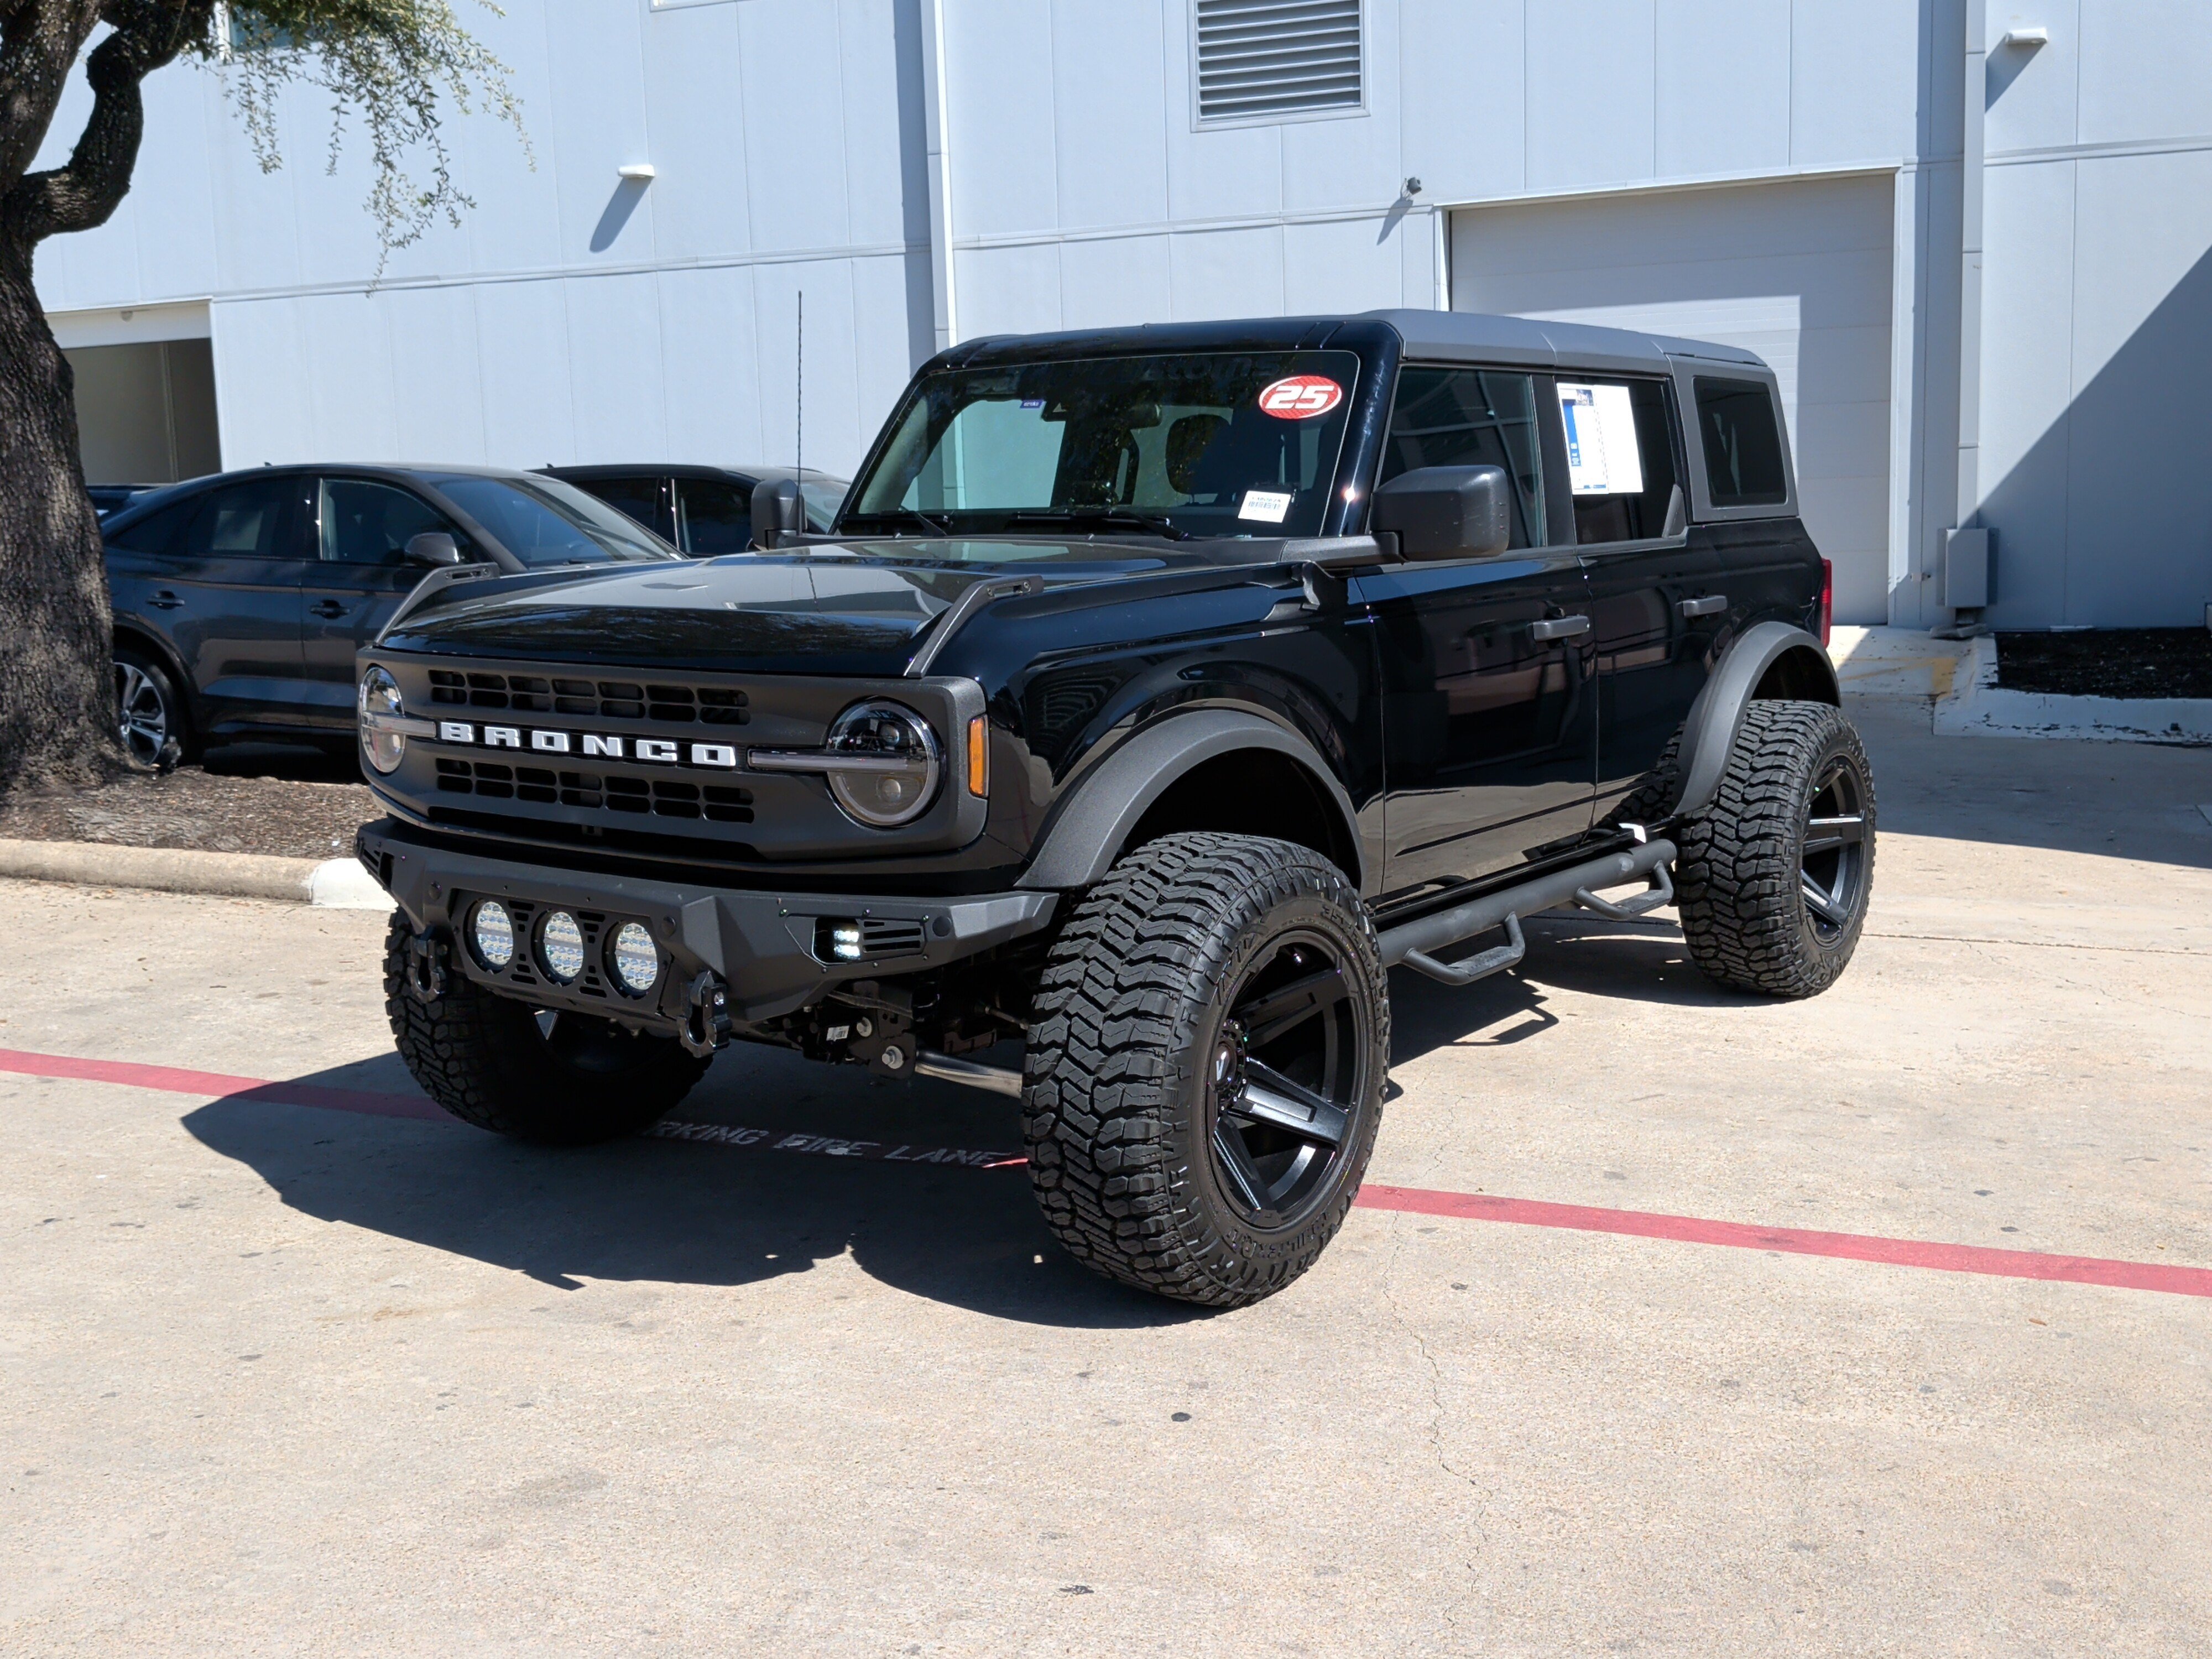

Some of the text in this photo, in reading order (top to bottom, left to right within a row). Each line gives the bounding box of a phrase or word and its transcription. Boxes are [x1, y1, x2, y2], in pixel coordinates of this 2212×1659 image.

[1265, 385, 1335, 409] 25
[441, 722, 737, 767] BRONCO
[650, 1120, 1011, 1165] RKING FIRE LANE
